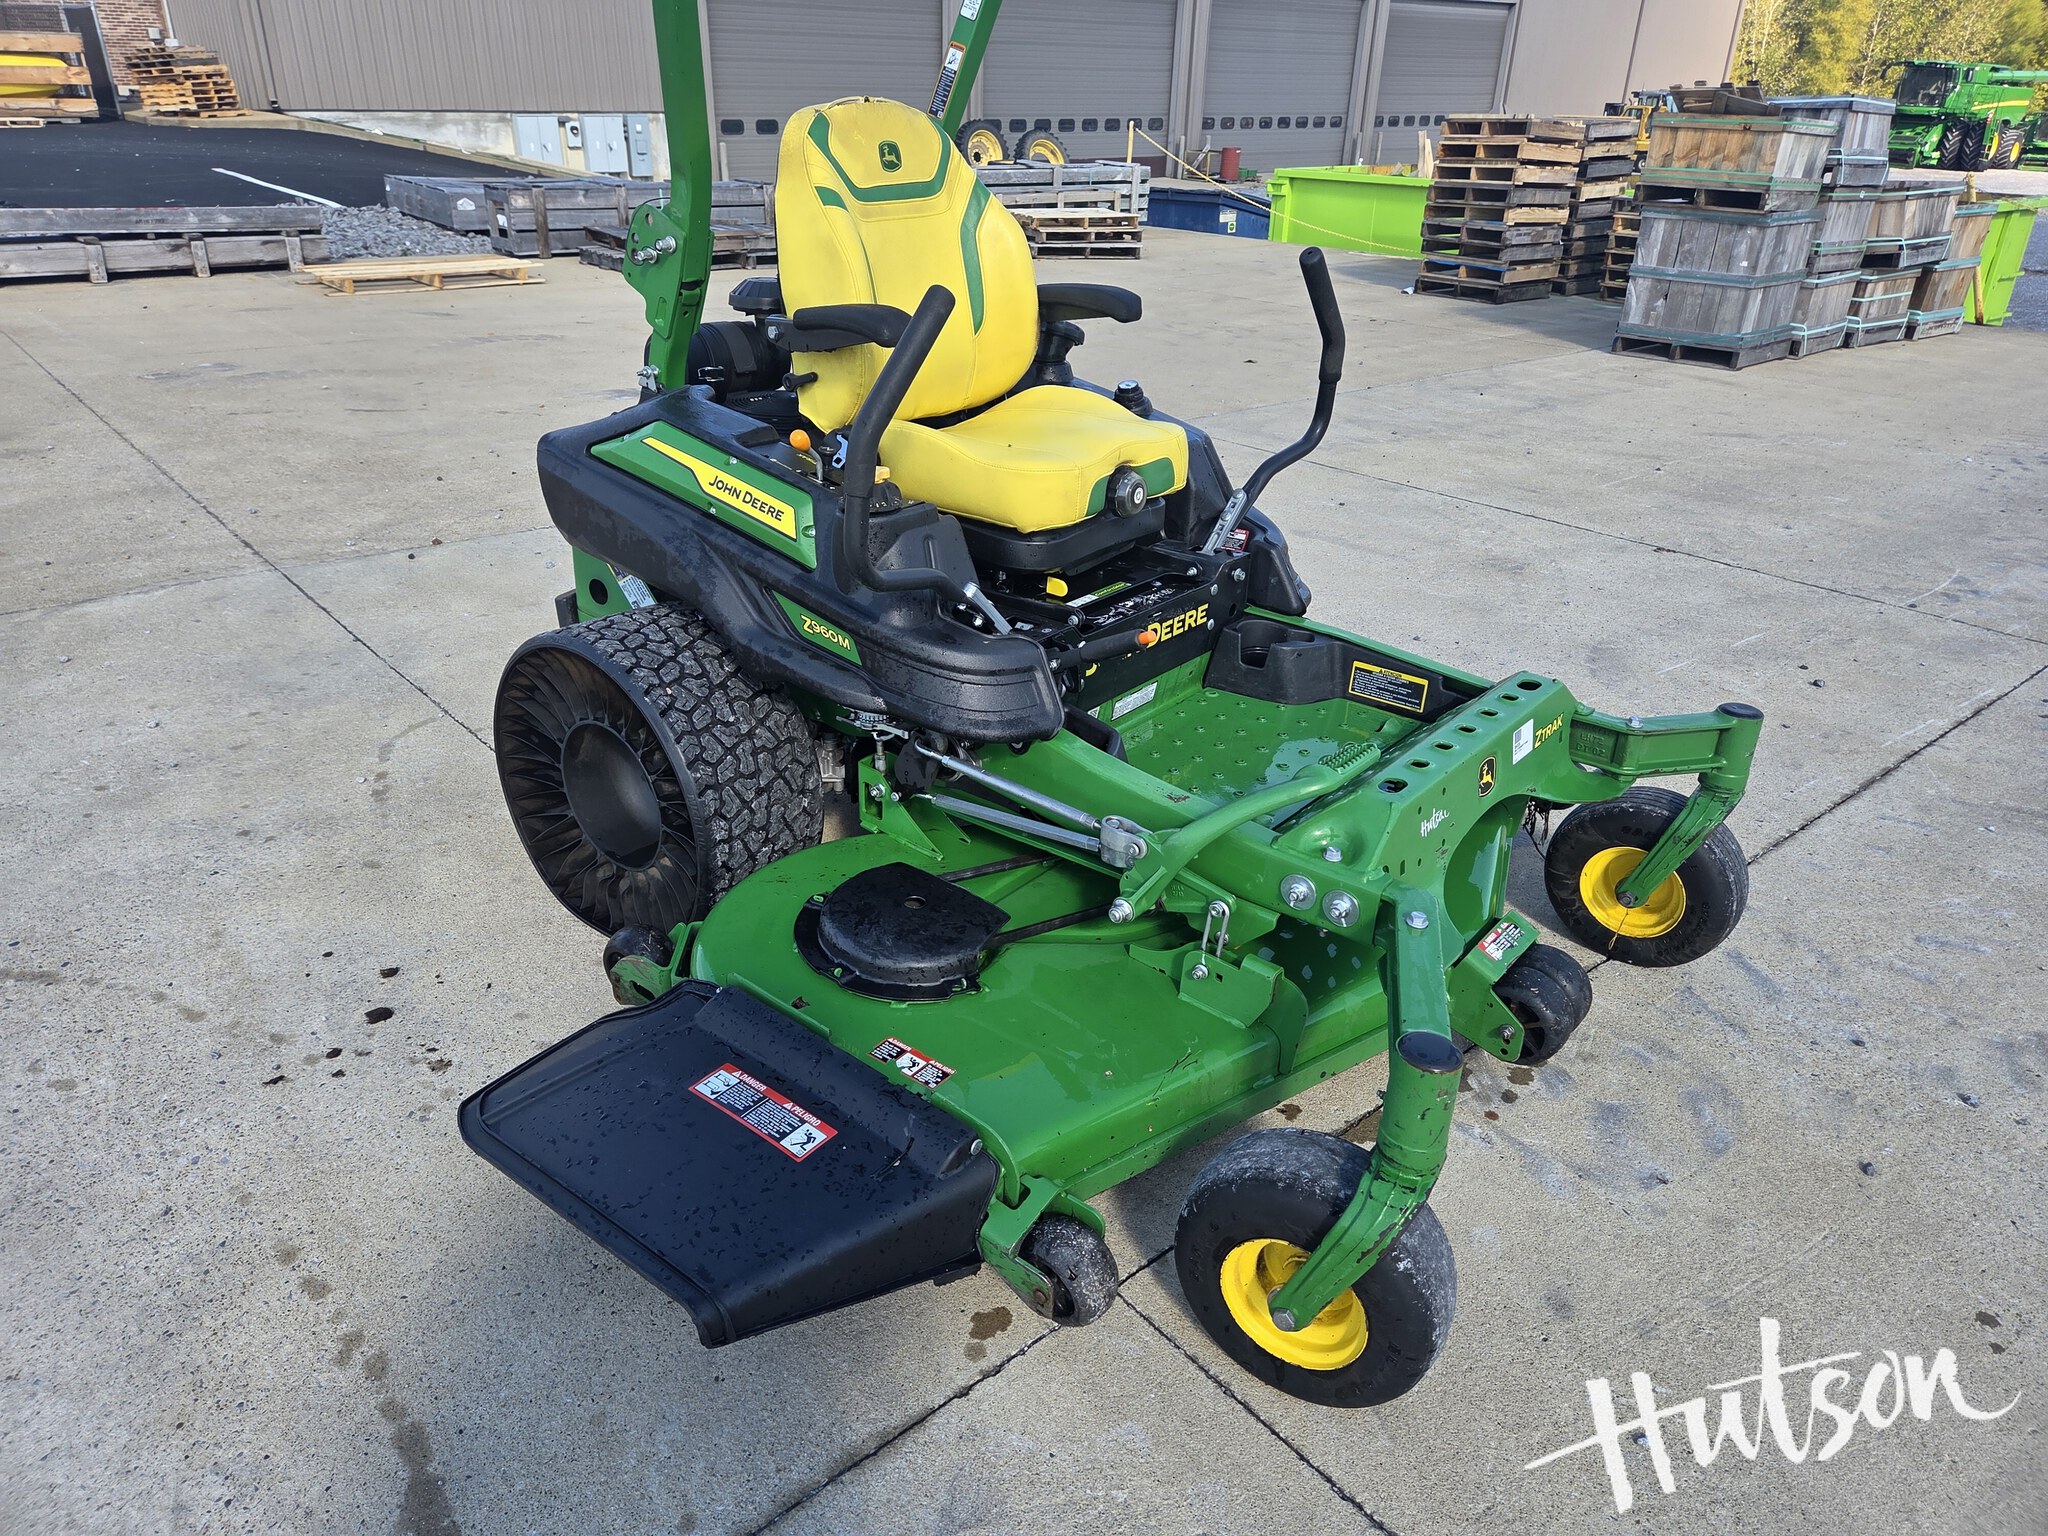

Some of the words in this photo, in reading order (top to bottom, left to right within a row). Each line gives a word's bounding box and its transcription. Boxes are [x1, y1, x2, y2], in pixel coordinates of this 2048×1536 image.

[708, 475, 742, 500] JOHN
[742, 491, 785, 522] DEERE
[800, 614, 851, 651] Z960M
[1146, 603, 1209, 649] DEERE
[1534, 713, 1564, 749] ZTRAK
[739, 1073, 767, 1093] DANGER
[791, 1103, 822, 1128] PELIGRO
